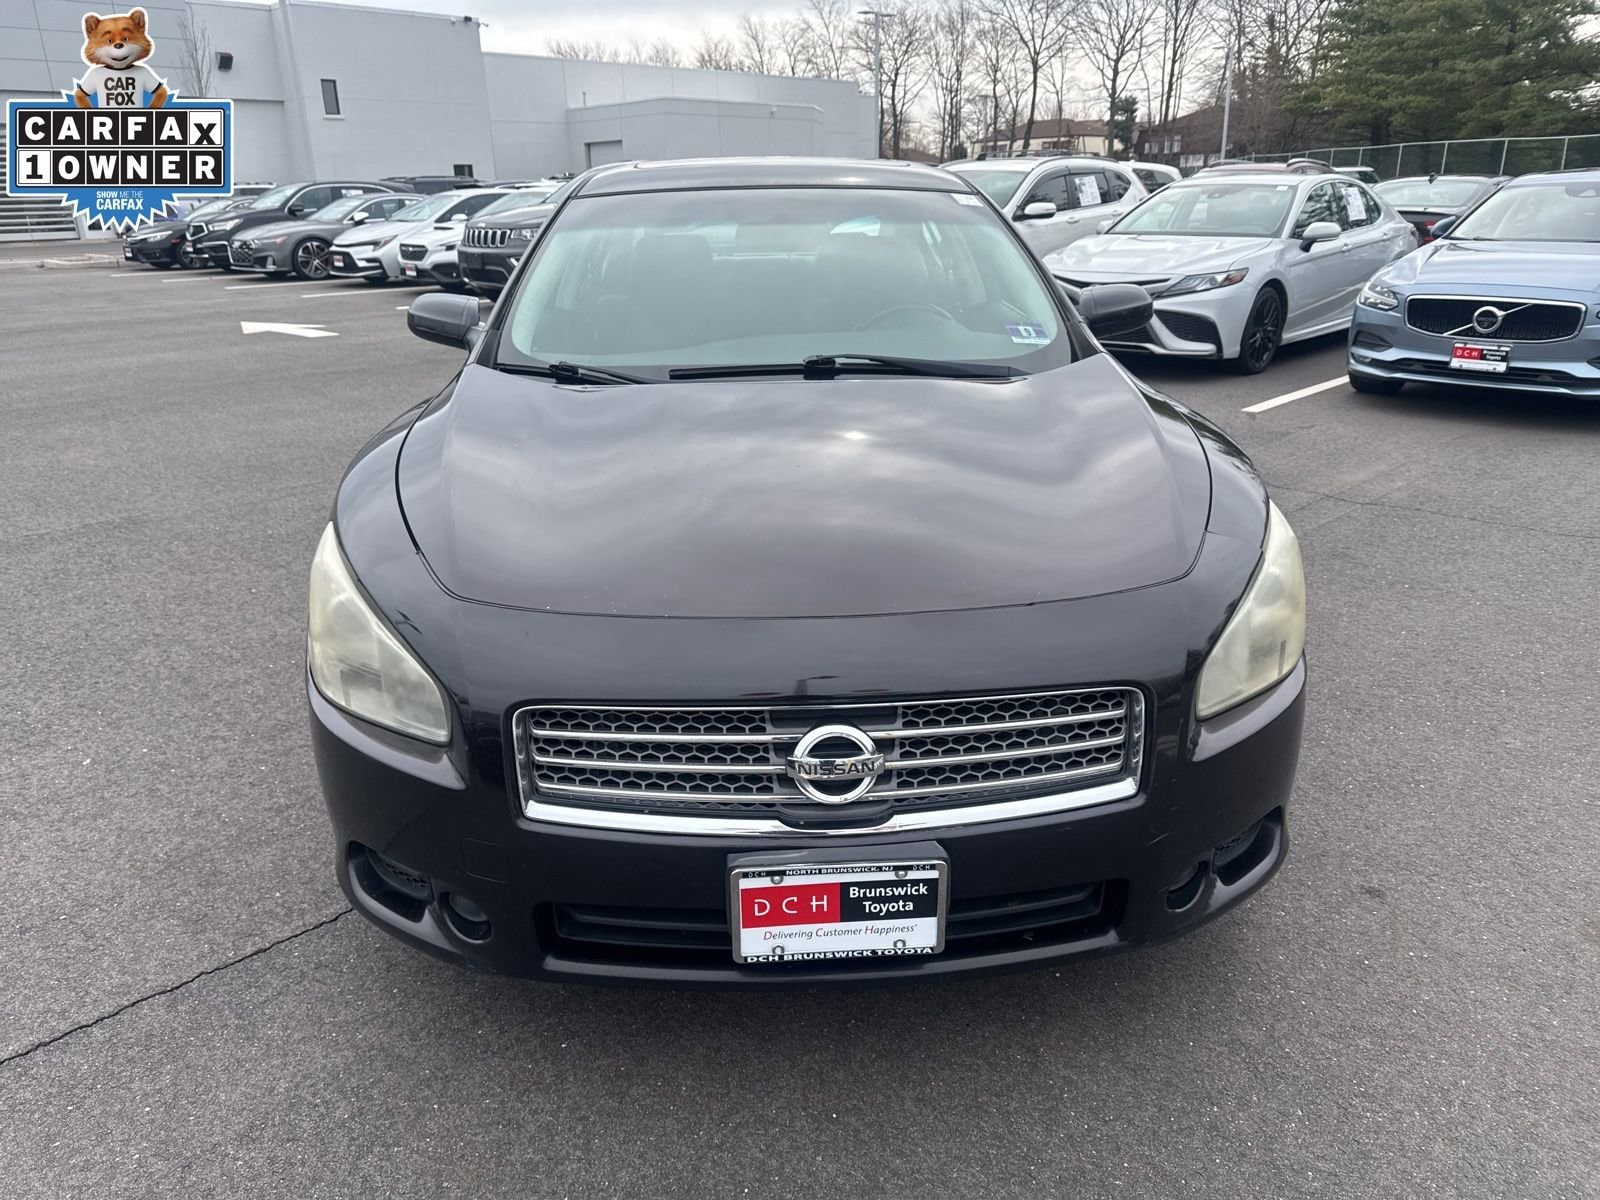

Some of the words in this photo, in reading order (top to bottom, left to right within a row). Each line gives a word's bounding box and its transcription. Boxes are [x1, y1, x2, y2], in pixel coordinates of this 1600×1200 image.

[797, 760, 875, 776] NISSAN
[849, 882, 928, 898] Brunswick
[862, 899, 914, 916] Toyota
[763, 930, 813, 941] Delivering
[815, 927, 863, 938] Customer
[864, 924, 914, 936] Happiness
[747, 955, 779, 963] DCH
[783, 950, 873, 961] BRUNSWICK
[876, 947, 933, 956] TOYOTA
